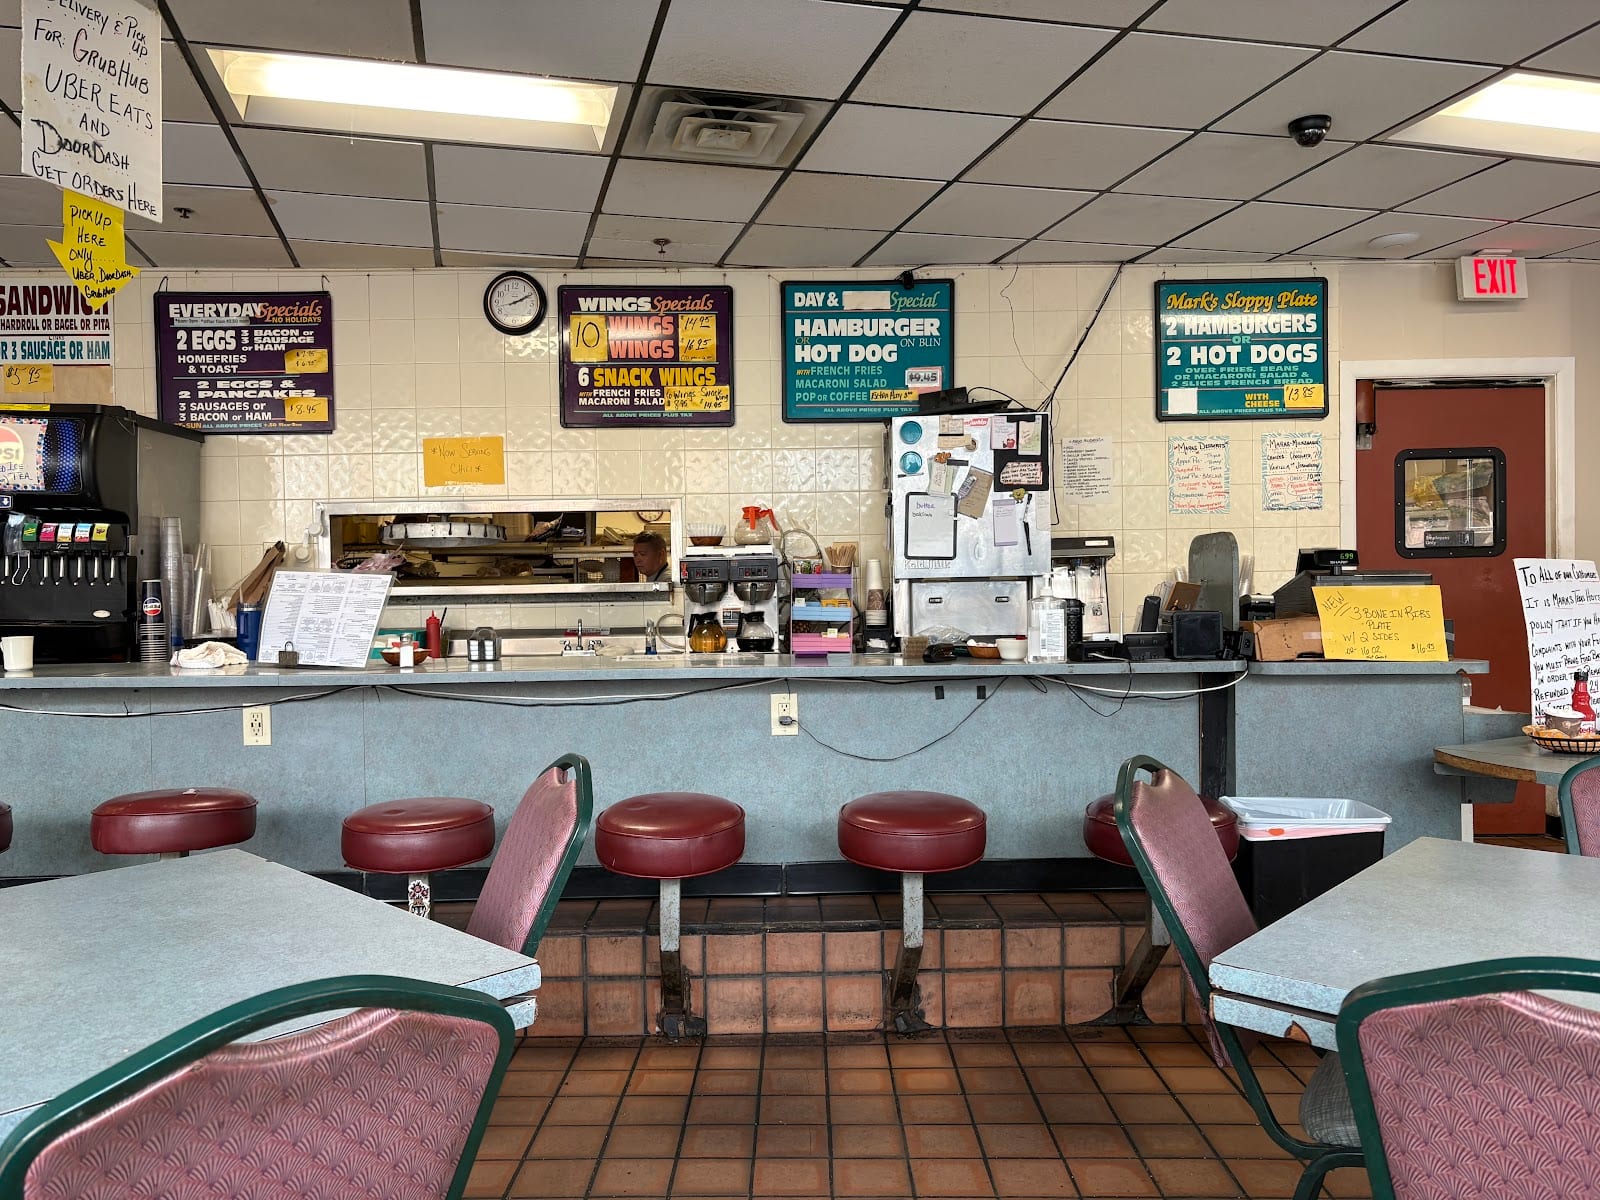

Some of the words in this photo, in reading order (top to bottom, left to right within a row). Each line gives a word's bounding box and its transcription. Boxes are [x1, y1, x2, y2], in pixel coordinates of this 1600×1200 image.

[47, 0, 109, 36] ELIVERY
[45, 64, 105, 112] UBER
[110, 94, 153, 130] EATS
[79, 114, 110, 137] AND
[32, 151, 68, 184] GET
[72, 172, 124, 201] ORDERS
[128, 181, 158, 216] HERE
[77, 225, 106, 247] HERE
[1473, 258, 1517, 294] EXIT
[578, 297, 651, 312] WINGS
[650, 294, 715, 315] Specials
[794, 293, 825, 307] DAY
[827, 292, 839, 307] &
[890, 291, 941, 312] Special
[1167, 292, 1219, 312] Mark's
[1222, 291, 1273, 313] Sloppy
[1277, 290, 1319, 309] Plate
[169, 303, 262, 318] EVERYDAY
[255, 300, 323, 323] Specials
[1, 319, 40, 331] HARDROLL
[42, 319, 53, 331] OR
[55, 318, 78, 331] BAGEL
[81, 318, 92, 331] OR
[93, 318, 110, 331] PITA
[608, 316, 674, 336] WINGS
[794, 318, 940, 338] HAMBURGER
[1166, 317, 1178, 336] 2
[1184, 314, 1317, 336] HAMBURGERS
[177, 330, 187, 350] 2
[192, 330, 237, 350] EGGS
[575, 321, 601, 349] 10
[900, 338, 915, 348] ON
[1232, 336, 1251, 345] OR
[11, 341, 18, 361] 3
[20, 340, 66, 361] SAUSAGE
[69, 340, 84, 360] OR
[87, 339, 111, 360] HAM
[609, 340, 674, 359] WINGS
[794, 344, 842, 363] HOT
[849, 344, 898, 363] DOG
[1167, 347, 1181, 366] 2
[1191, 345, 1241, 365] HOT
[1251, 344, 1317, 364] DOGS
[178, 355, 247, 364] HOMEFRIES
[188, 365, 196, 373] &
[200, 364, 238, 373] TOAST
[578, 367, 589, 387] 6
[594, 367, 653, 387] SNACK
[659, 367, 716, 388] WINGS
[811, 367, 850, 376] FRENCH
[854, 366, 882, 376] FRIES
[594, 389, 630, 398] FRENCH
[635, 389, 661, 398] FRIES
[795, 380, 850, 389] MACARONI
[853, 379, 887, 388] SALAD
[179, 390, 191, 398] 2
[198, 390, 316, 398] PANCAKES
[579, 397, 630, 406] MACARONI
[634, 397, 665, 406] SALAD
[796, 392, 816, 402] POP
[829, 392, 868, 402] COFFEE
[1245, 393, 1269, 401] WITH
[179, 413, 186, 421] 3
[190, 413, 228, 421] BACON
[246, 412, 272, 420] HAM
[190, 403, 249, 411] SAUSAGES
[1540, 566, 1554, 582] ALL
[1554, 570, 1562, 580] OF
[1321, 591, 1345, 611] NEW
[1525, 597, 1539, 609] IT
[1544, 598, 1551, 608] IS
[1363, 607, 1388, 619] BONE
[1390, 610, 1403, 618] IN
[1404, 606, 1431, 621] RIBS
[1366, 621, 1391, 630] PLATE
[1529, 618, 1554, 637] POLICY
[1573, 618, 1581, 628] IF
[1533, 661, 1544, 680] YOU
[1545, 661, 1562, 671] MUST
[1547, 673, 1568, 684] ORDER
[1534, 687, 1569, 701] REFUNDED
